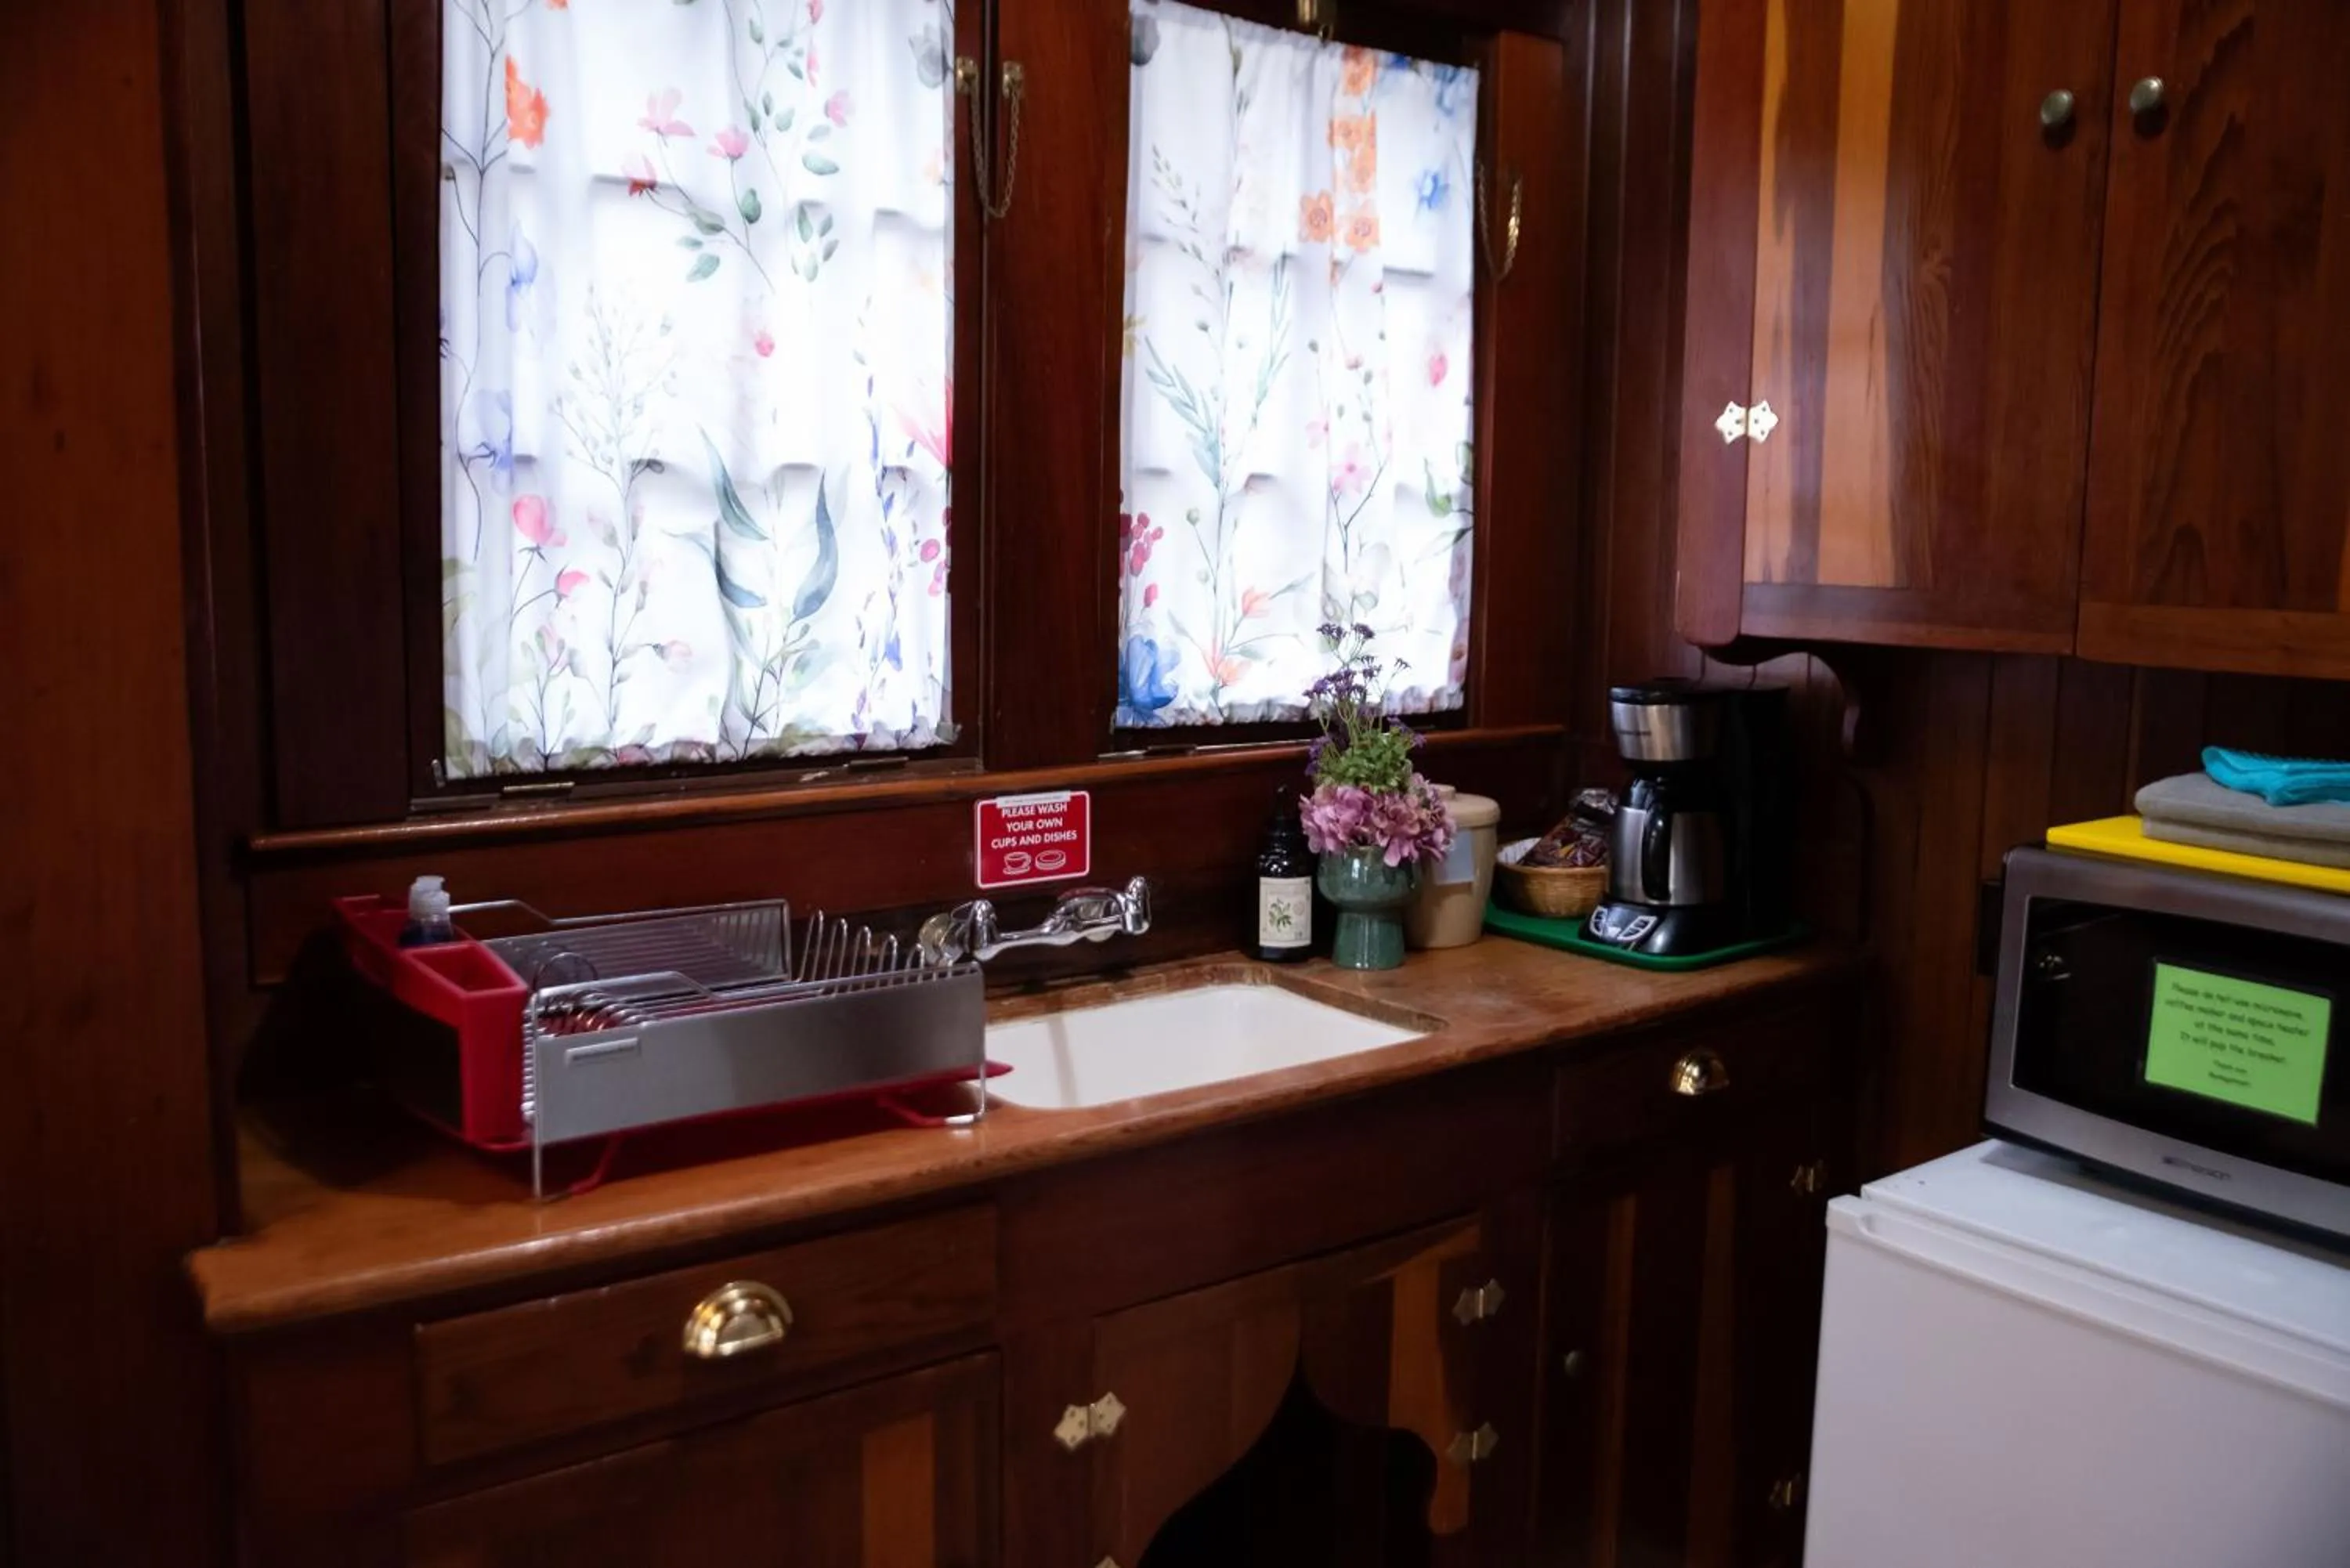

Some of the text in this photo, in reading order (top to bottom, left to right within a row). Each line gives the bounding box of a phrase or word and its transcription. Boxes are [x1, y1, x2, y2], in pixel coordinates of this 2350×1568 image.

[1002, 802, 1068, 818] PLEASE WASH
[1006, 818, 1063, 833] YOUR OWN
[991, 830, 1077, 849] CUPS AND DISHES
[2171, 981, 2199, 997] Please
[2201, 989, 2214, 999] do
[2215, 992, 2232, 1003] not
[2234, 998, 2250, 1007] use
[2164, 997, 2194, 1011] coffee
[2196, 1005, 2226, 1017] maker
[2228, 1011, 2245, 1023] and
[2247, 1016, 2274, 1029] space
[2193, 1020, 2205, 1028] at
[2207, 1021, 2223, 1034] the
[2192, 1035, 2209, 1045] will
[2229, 1042, 2244, 1054] the
